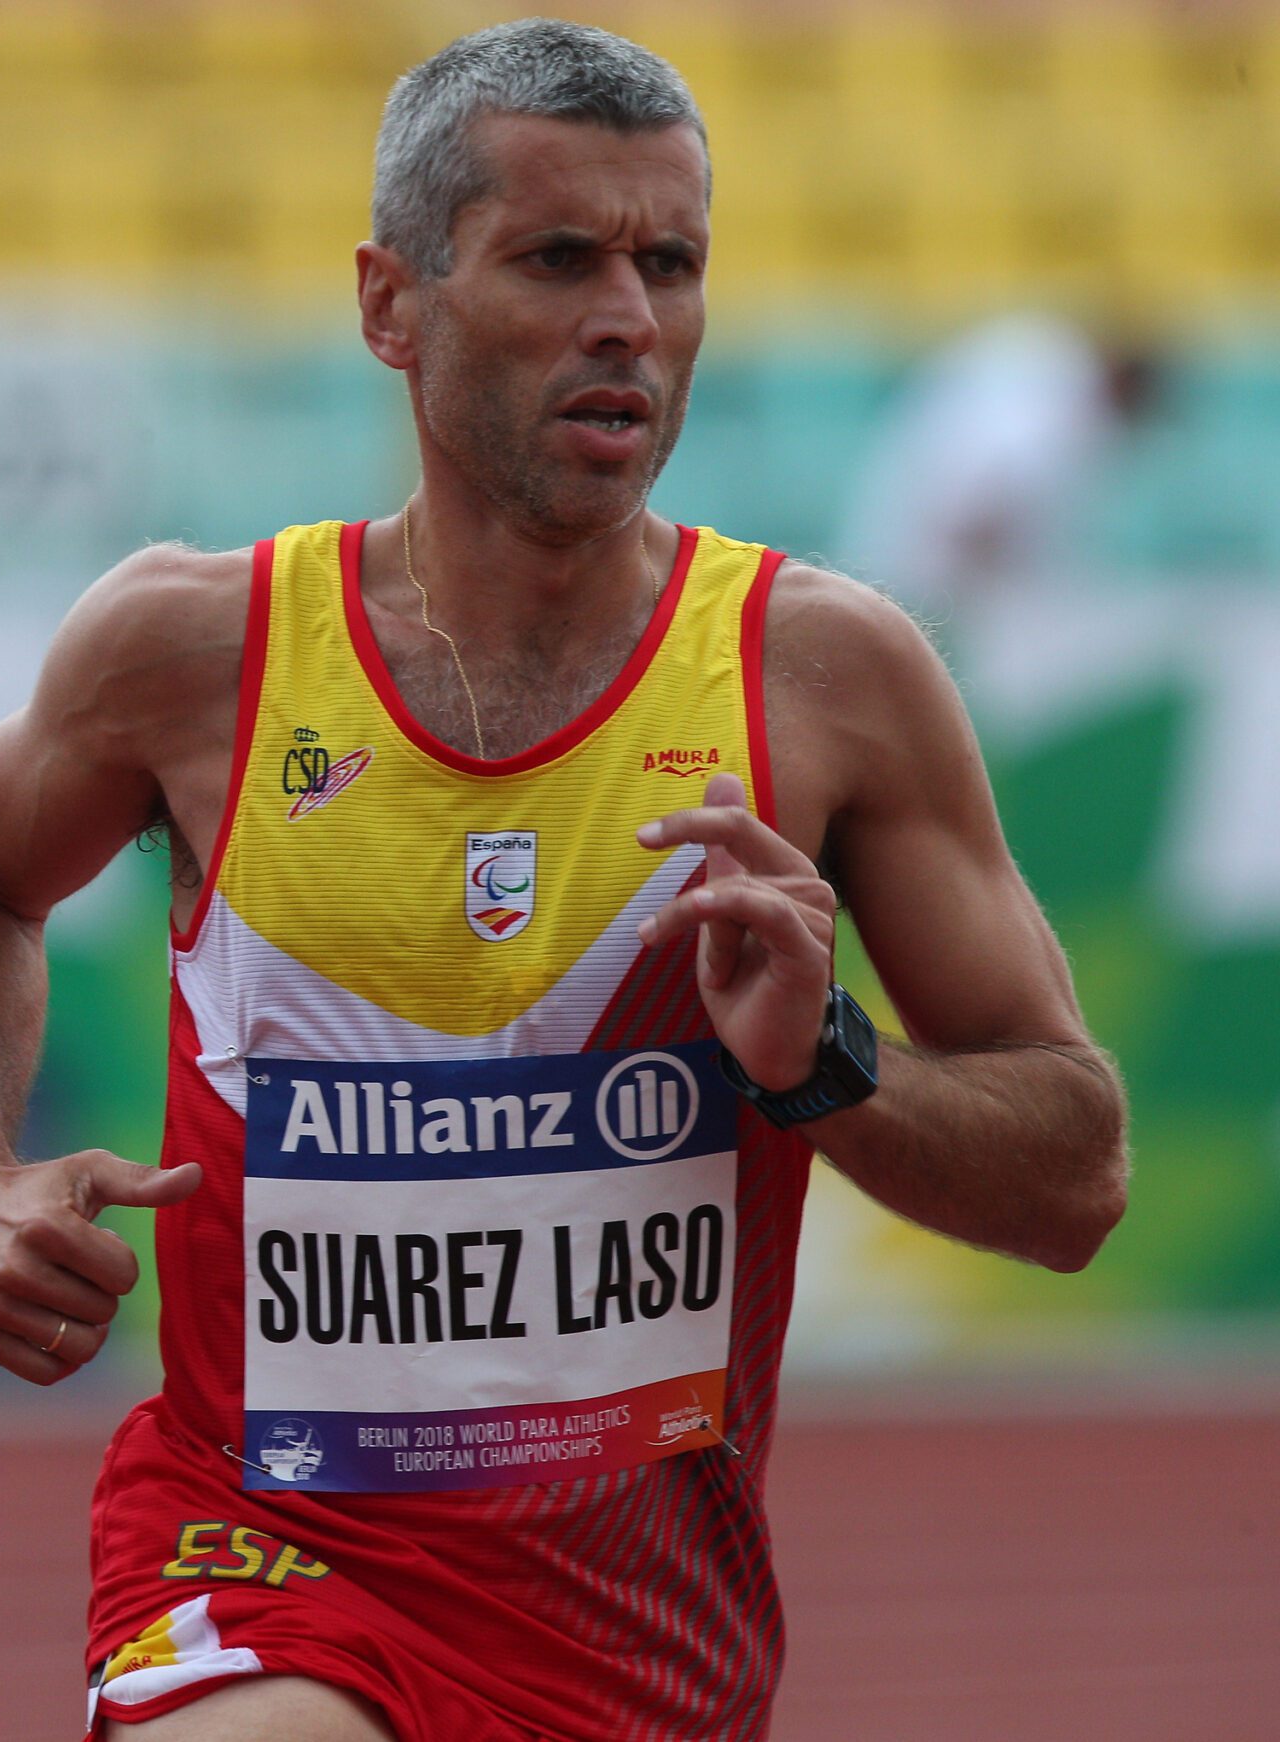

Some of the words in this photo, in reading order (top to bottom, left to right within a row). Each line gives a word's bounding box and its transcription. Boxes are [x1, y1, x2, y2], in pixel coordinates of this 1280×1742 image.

[282, 746, 330, 795] CSD
[641, 747, 721, 773] AMURA
[470, 836, 533, 852] España
[279, 1079, 576, 1157] Allianz
[257, 1228, 527, 1346] SUAREZ
[552, 1203, 725, 1337] LASO
[357, 1426, 410, 1448] BERLIN
[413, 1425, 455, 1447] 2018
[459, 1420, 515, 1445] WORLD
[519, 1417, 560, 1440] PARA
[562, 1404, 632, 1436] ATHLETICS
[393, 1449, 476, 1473] EUROPEAN
[479, 1435, 604, 1468] CHAMPIONSHIPS
[161, 1519, 333, 1590] ESP
